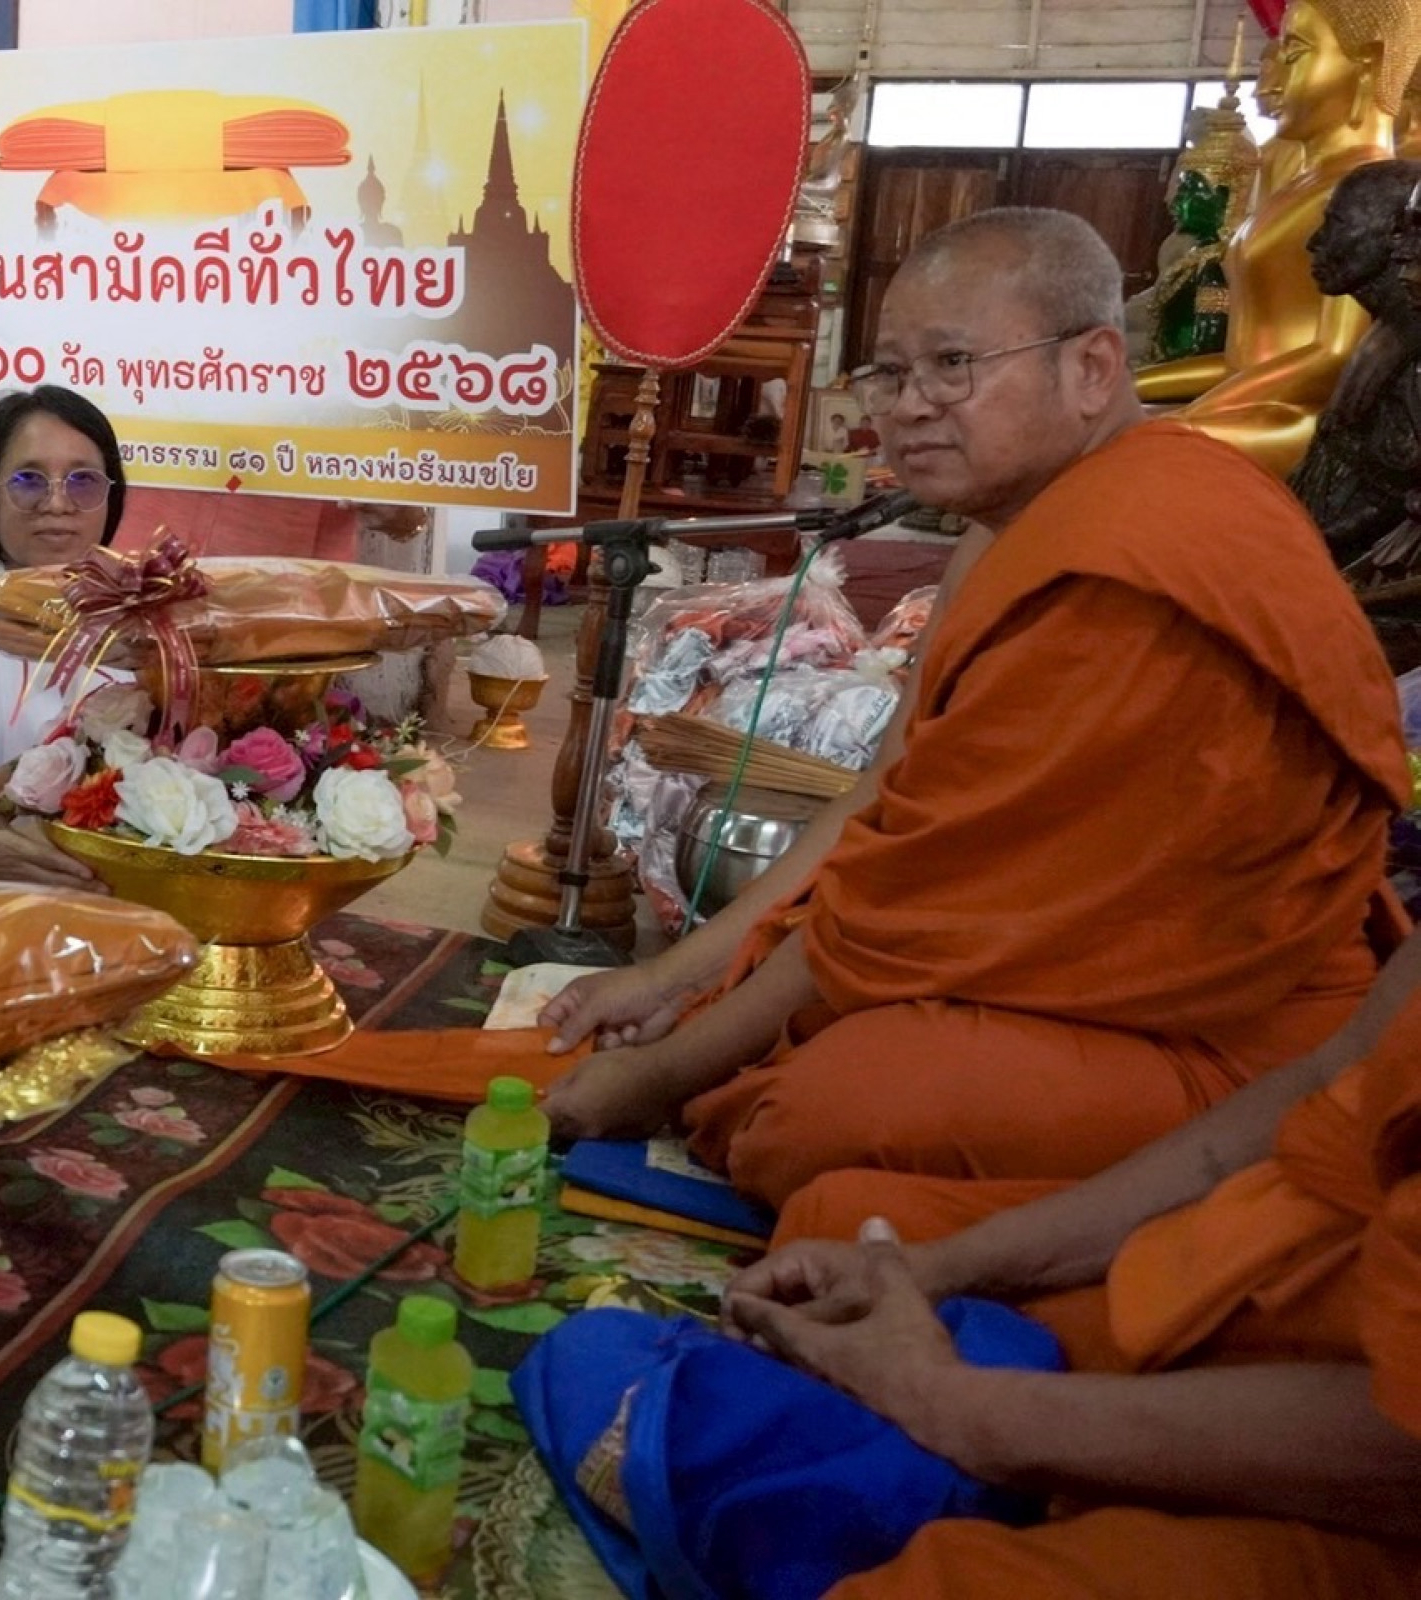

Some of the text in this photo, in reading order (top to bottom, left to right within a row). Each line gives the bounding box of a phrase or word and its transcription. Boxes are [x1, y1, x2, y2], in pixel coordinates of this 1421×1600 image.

[61, 343, 104, 387] วัด
[117, 346, 326, 404] พุทธศักราช
[345, 348, 549, 406] ๒๕๖๘
[118, 440, 218, 470] ชาธรรม
[228, 449, 266, 472] ๘๑
[276, 443, 295, 473] ปี
[305, 449, 536, 489] หลวงพ่อธัมมชโย
